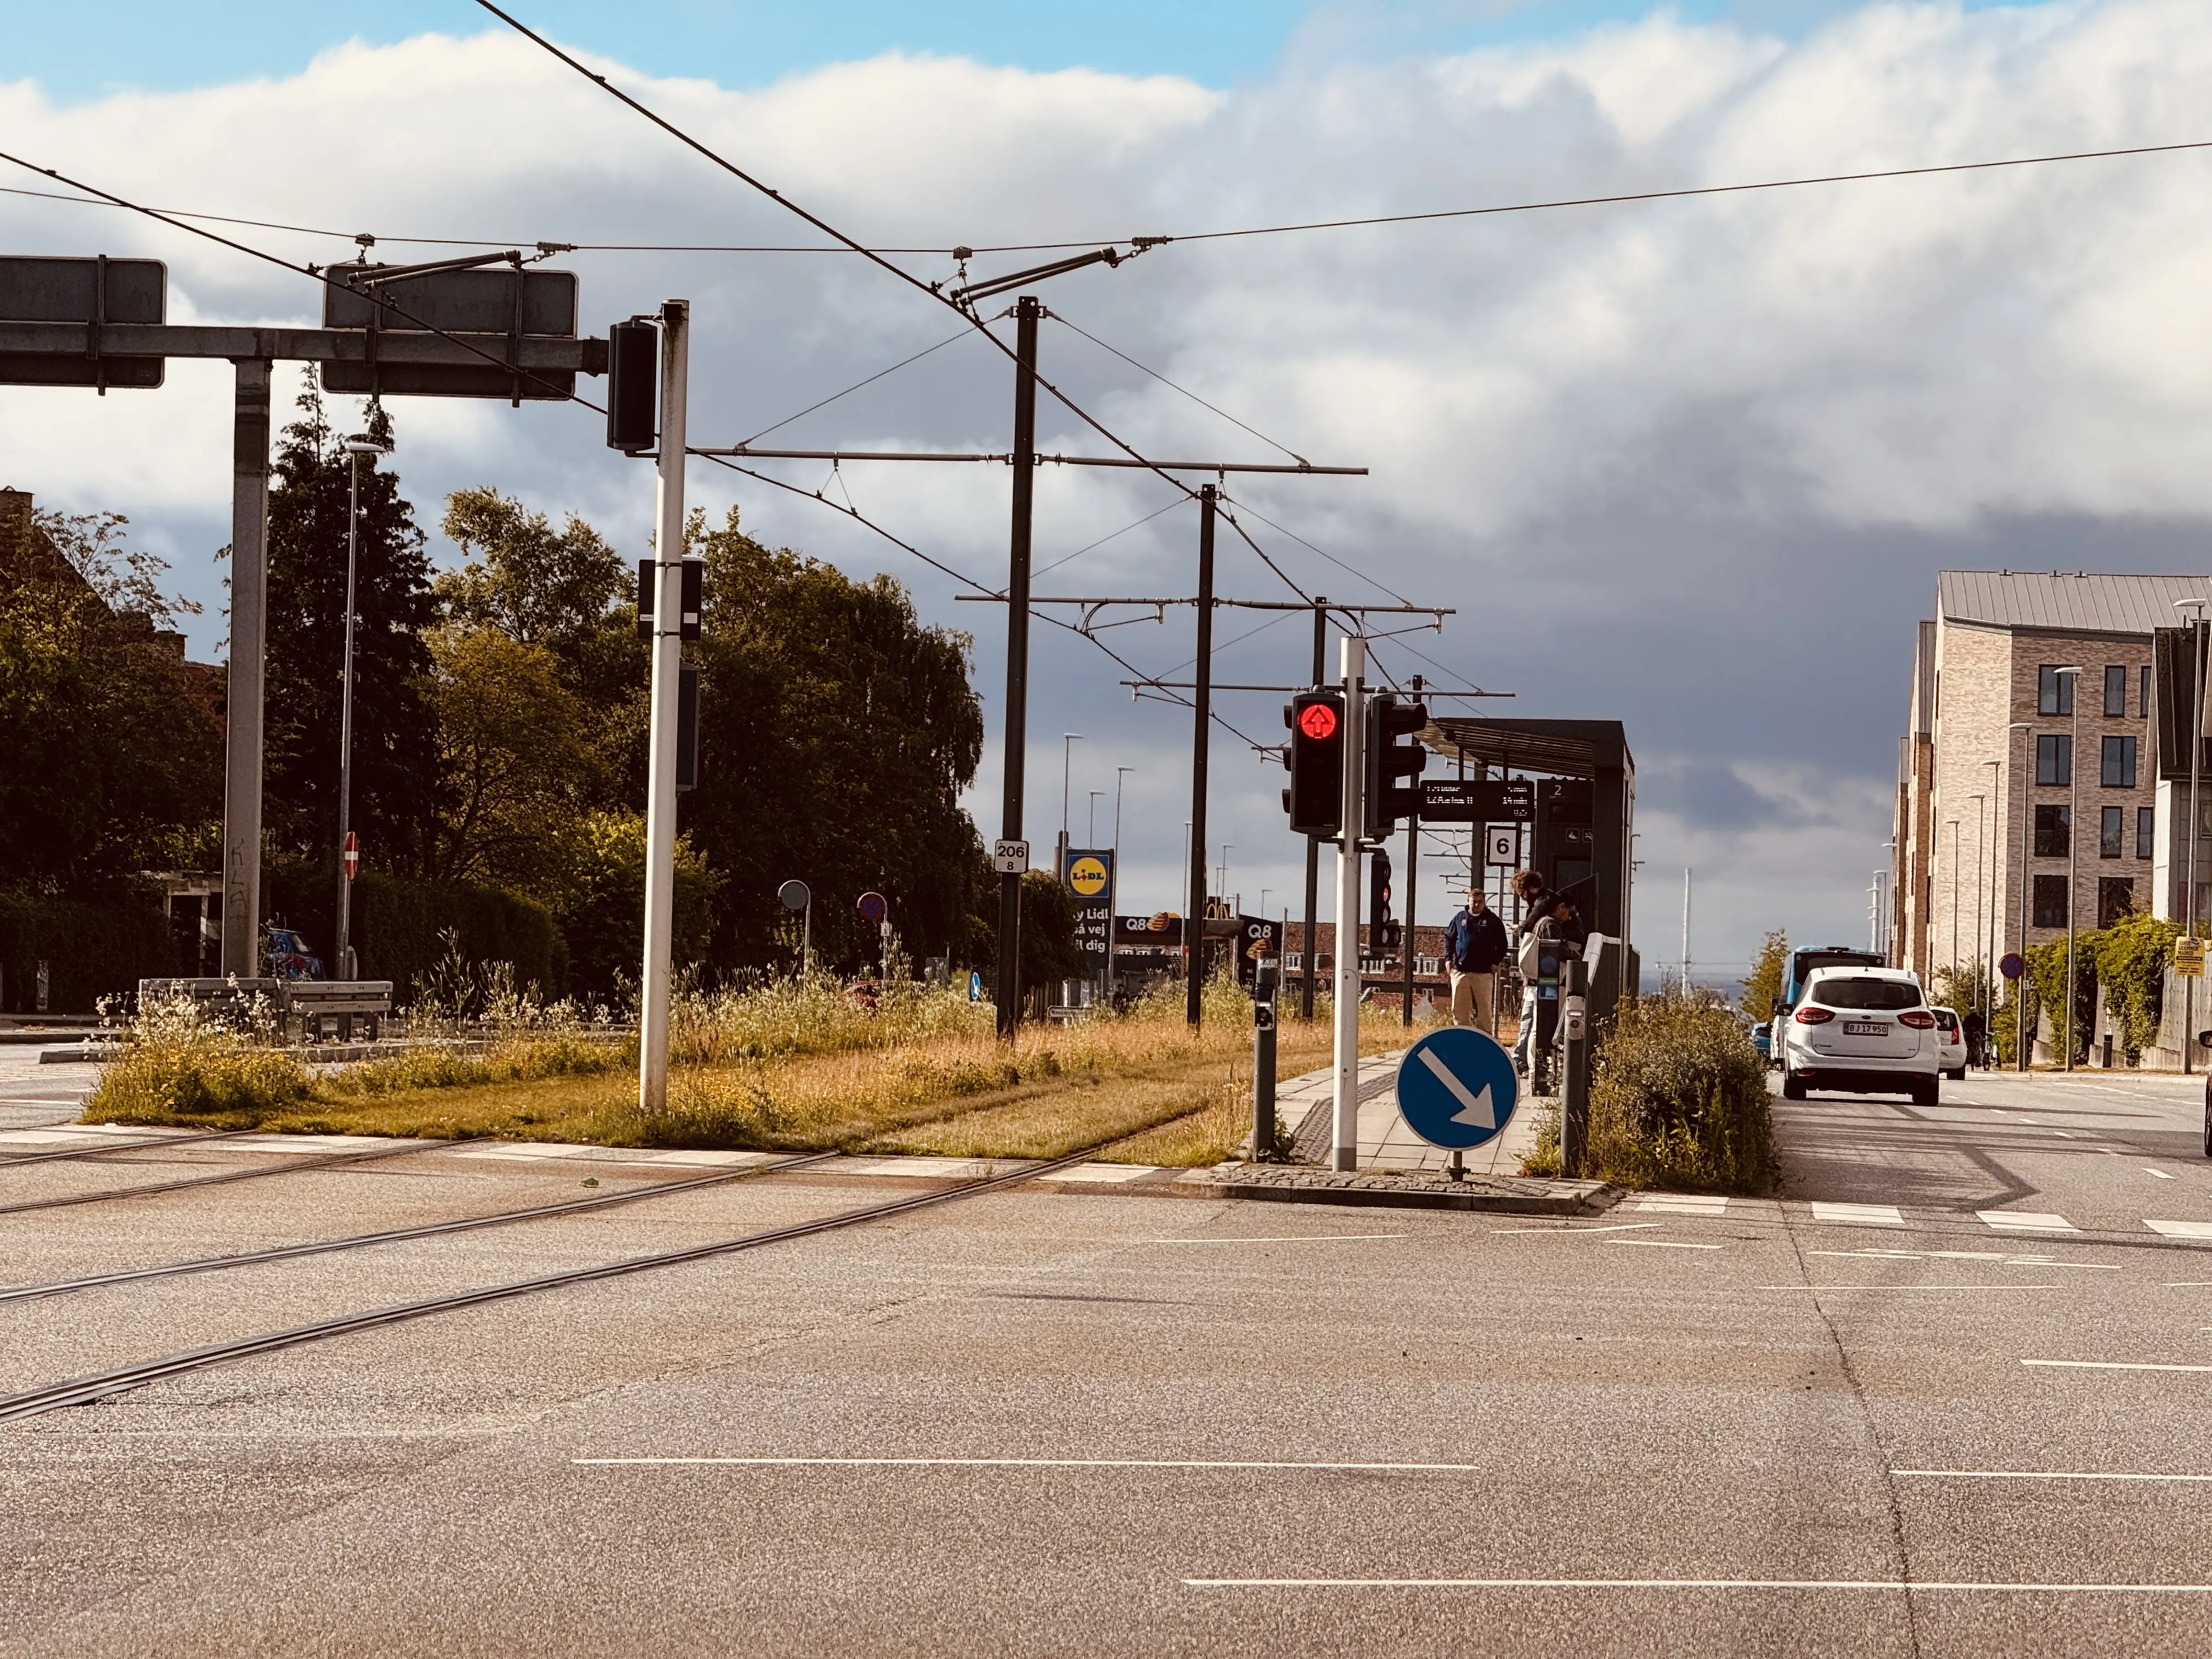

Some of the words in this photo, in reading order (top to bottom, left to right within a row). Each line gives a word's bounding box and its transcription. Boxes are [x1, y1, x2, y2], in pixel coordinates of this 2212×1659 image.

[1554, 785, 1562, 795] 2
[997, 845, 1024, 857] 206
[1497, 838, 1509, 854] 6
[1007, 861, 1014, 870] 8
[1073, 911, 1084, 922] y
[1087, 908, 1109, 919] Lidl
[1088, 923, 1105, 937] vej
[1126, 918, 1146, 931] Q8
[1248, 924, 1272, 939] Q8
[1086, 939, 1105, 953] dig
